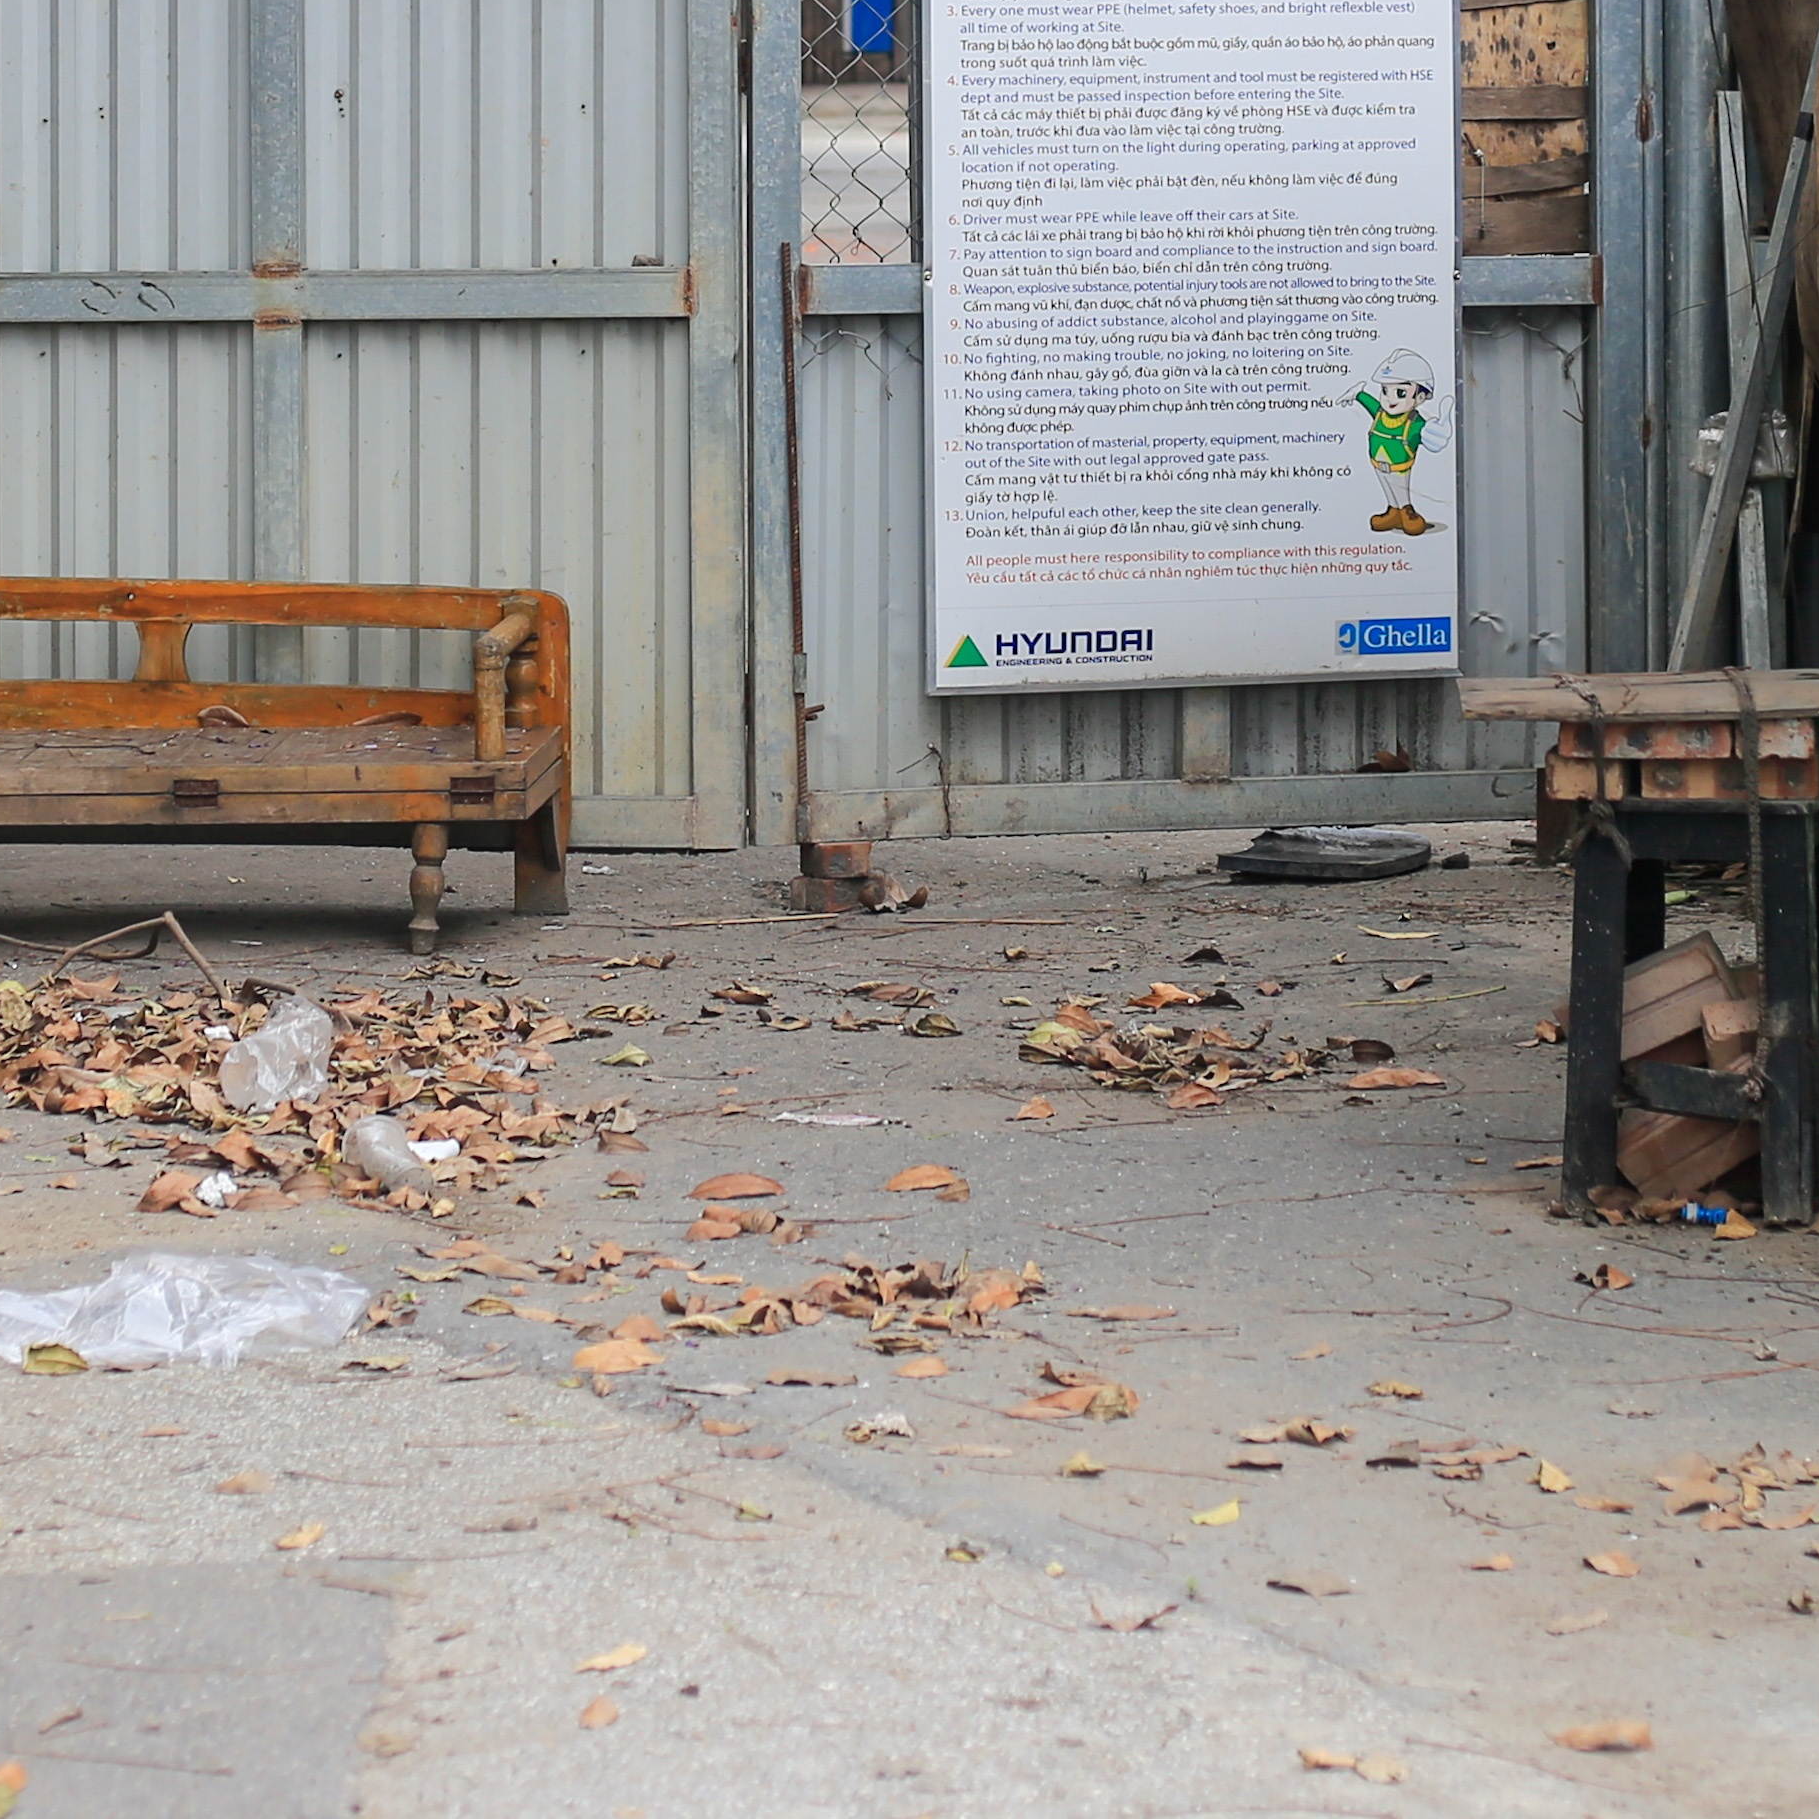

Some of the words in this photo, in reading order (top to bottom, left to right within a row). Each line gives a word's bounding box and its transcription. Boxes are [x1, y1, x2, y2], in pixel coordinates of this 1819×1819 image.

[960, 4, 996, 19] Every
[998, 7, 1024, 16] one
[1026, 5, 1059, 15] must
[1061, 6, 1094, 15] wear
[1096, 3, 1120, 15] PPE
[1178, 2, 1216, 17] safety
[1260, 1, 1285, 13] and
[1288, 1, 1327, 16] bright
[963, 353, 983, 364] No
[1042, 353, 1060, 362] no
[1062, 349, 1111, 365] making
[1166, 351, 1184, 360] no
[1232, 349, 1249, 358] no
[1251, 345, 1304, 360] loitering
[1306, 348, 1324, 357] on
[1067, 506, 1099, 518] each
[1141, 503, 1173, 518] keep
[1175, 503, 1197, 515] the
[1199, 504, 1222, 514] site
[1224, 501, 1258, 514] clean
[965, 554, 982, 566] All
[986, 553, 1032, 568] people
[1034, 554, 1067, 564] must
[1070, 551, 1100, 563] here
[1104, 549, 1189, 564] responsibility
[1191, 549, 1205, 560] to
[1207, 546, 1281, 561] compliance
[1282, 545, 1311, 557] with
[1314, 544, 1337, 556] this
[996, 629, 1153, 656] HYUNDAI
[1363, 623, 1447, 648] Ghella
[996, 657, 1063, 667] ENGINEERING
[1075, 654, 1153, 663] CONSTRUCTION
